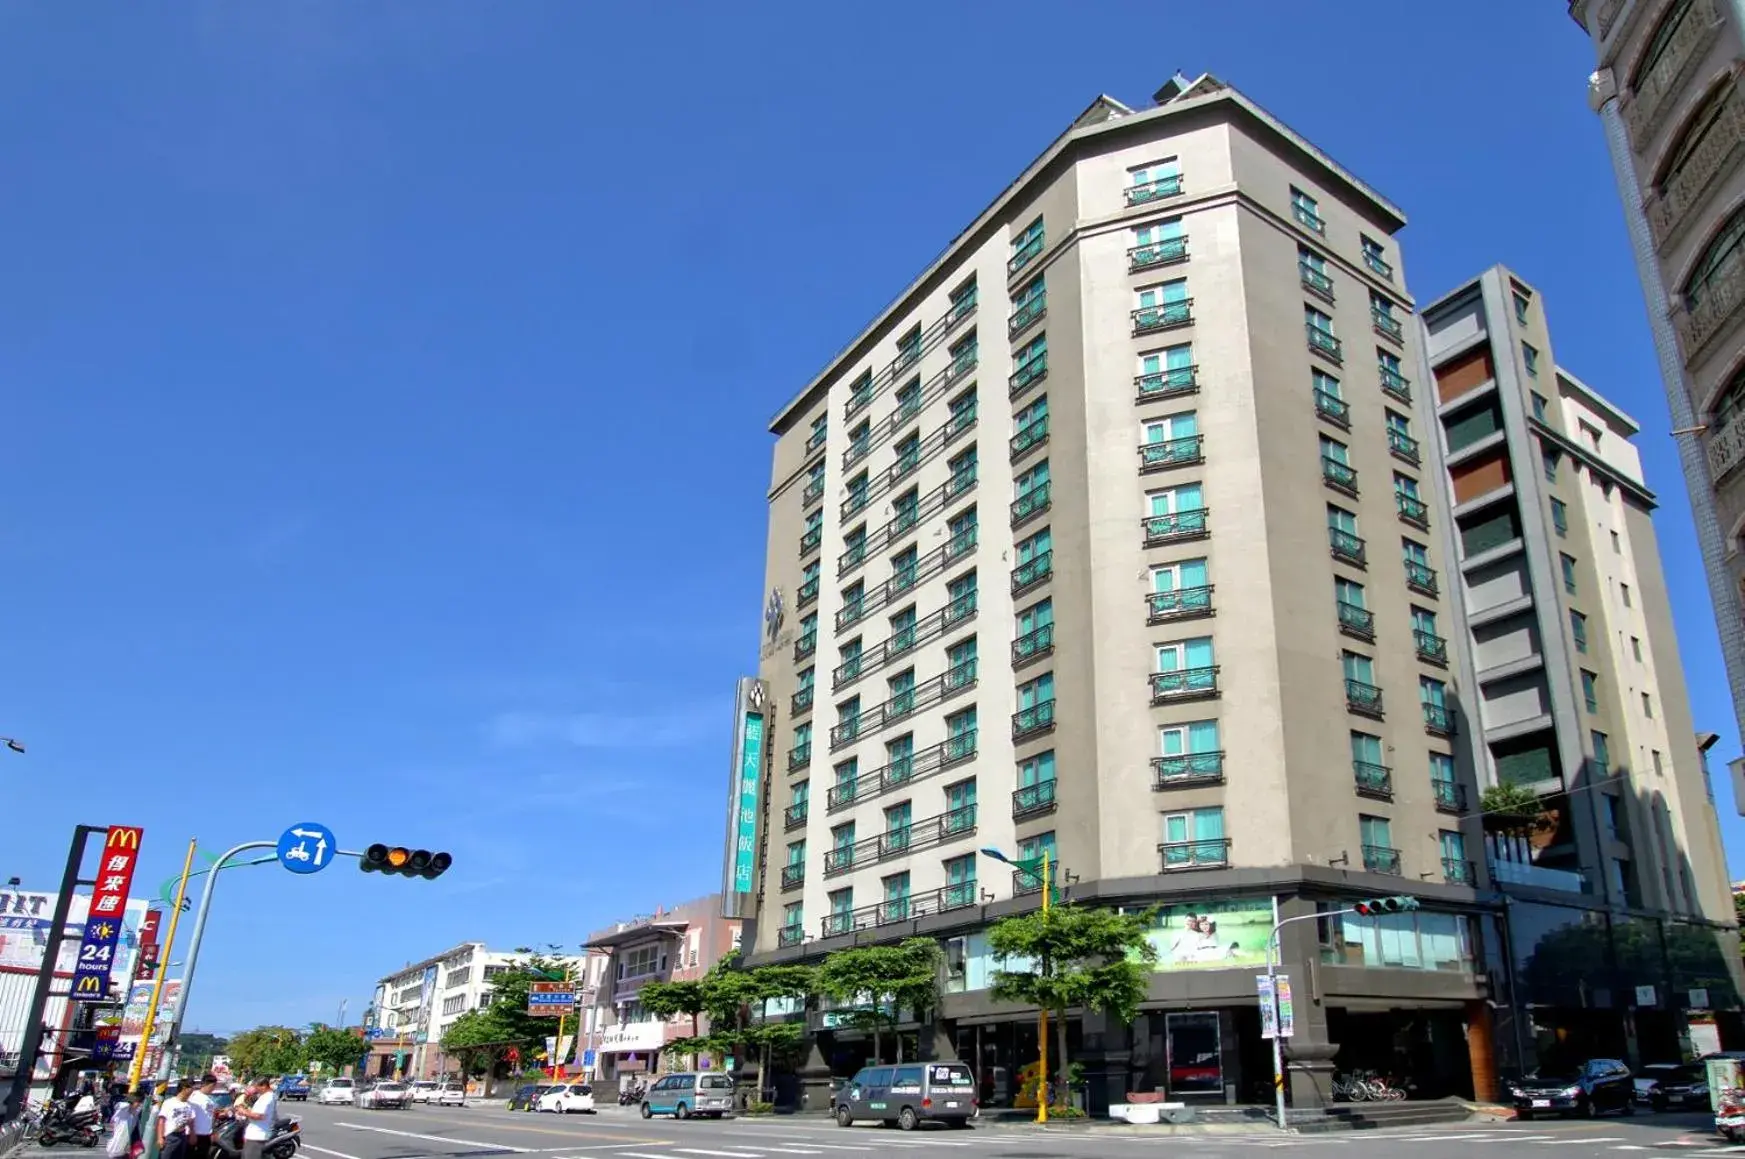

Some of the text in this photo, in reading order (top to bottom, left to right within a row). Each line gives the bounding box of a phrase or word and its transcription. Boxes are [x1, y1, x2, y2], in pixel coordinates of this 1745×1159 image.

[95, 855, 129, 911] 得來速
[81, 944, 110, 960] 24
[78, 962, 108, 970] hours
[114, 1042, 132, 1053] 24
